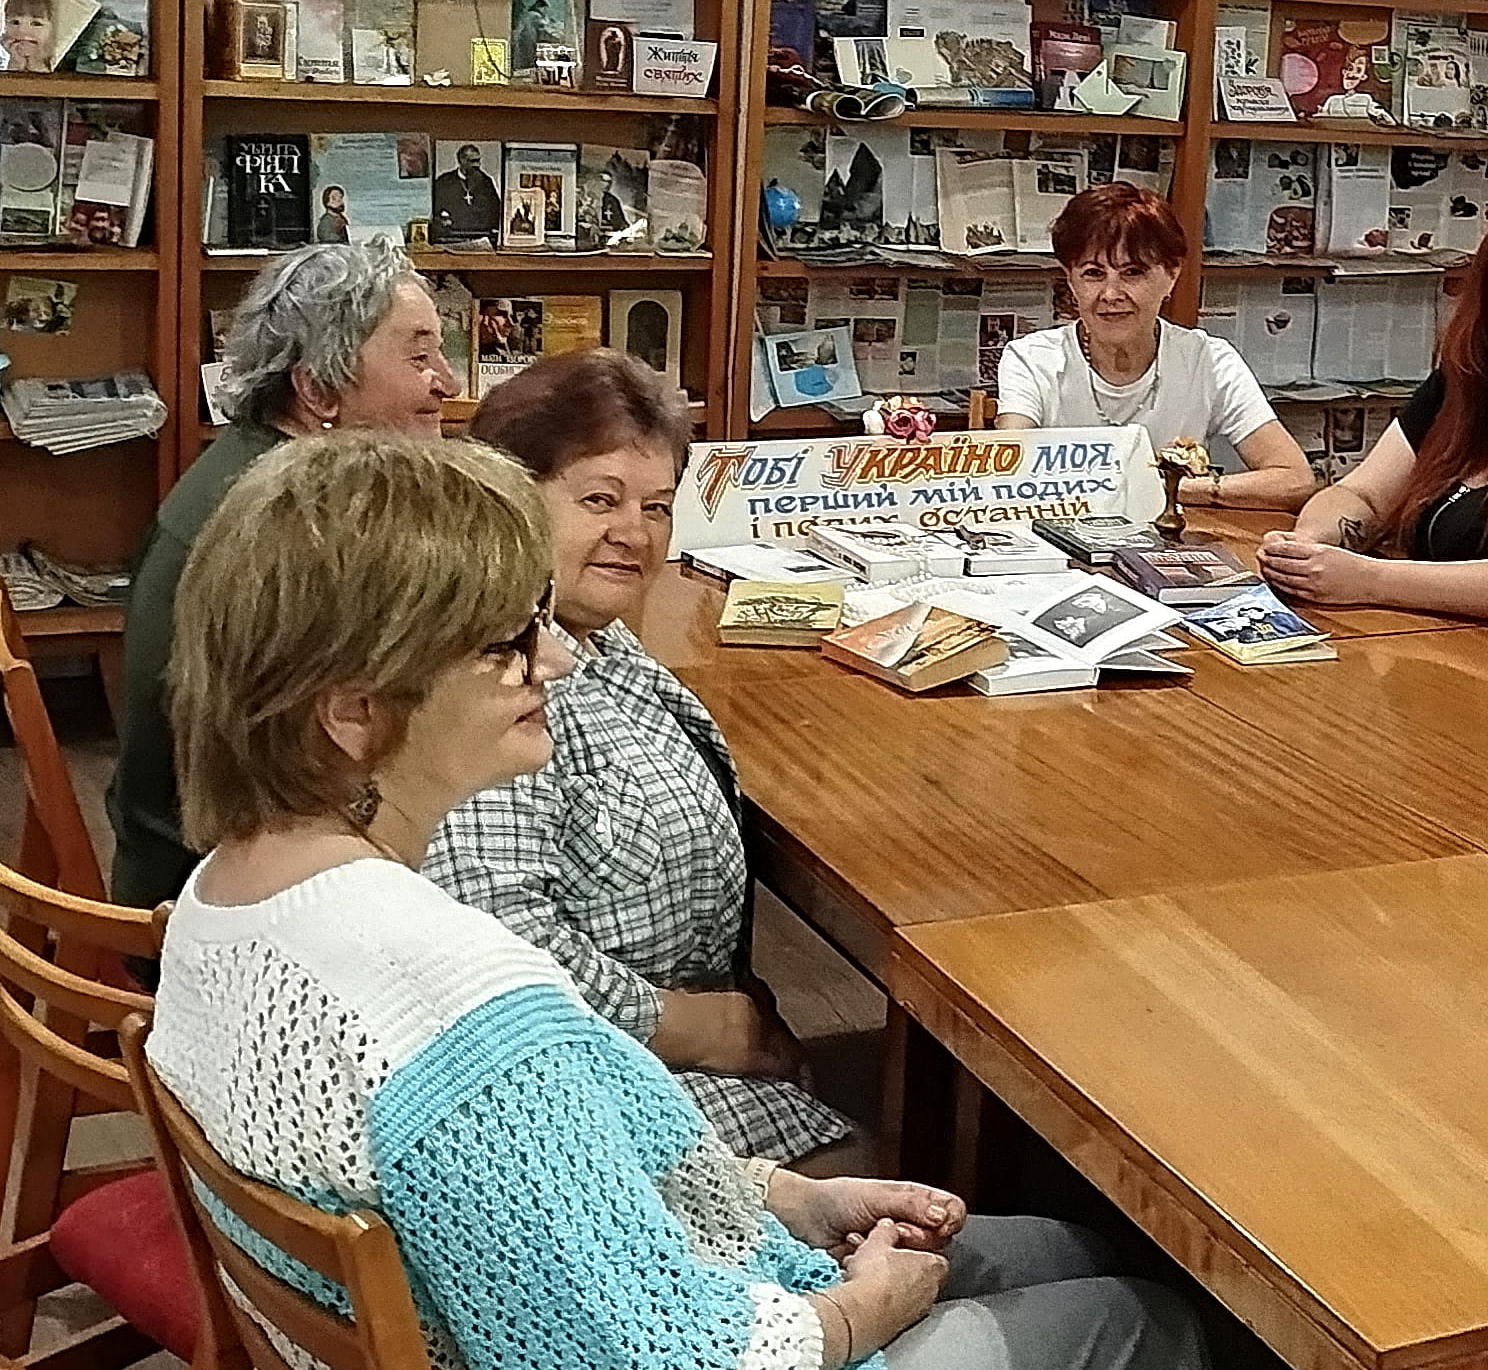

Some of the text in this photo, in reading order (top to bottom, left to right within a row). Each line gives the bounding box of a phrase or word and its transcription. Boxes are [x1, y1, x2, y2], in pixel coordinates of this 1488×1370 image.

[748, 477, 1117, 515] перший мій подих
[750, 516, 761, 539] і
[919, 496, 1092, 528] останній
